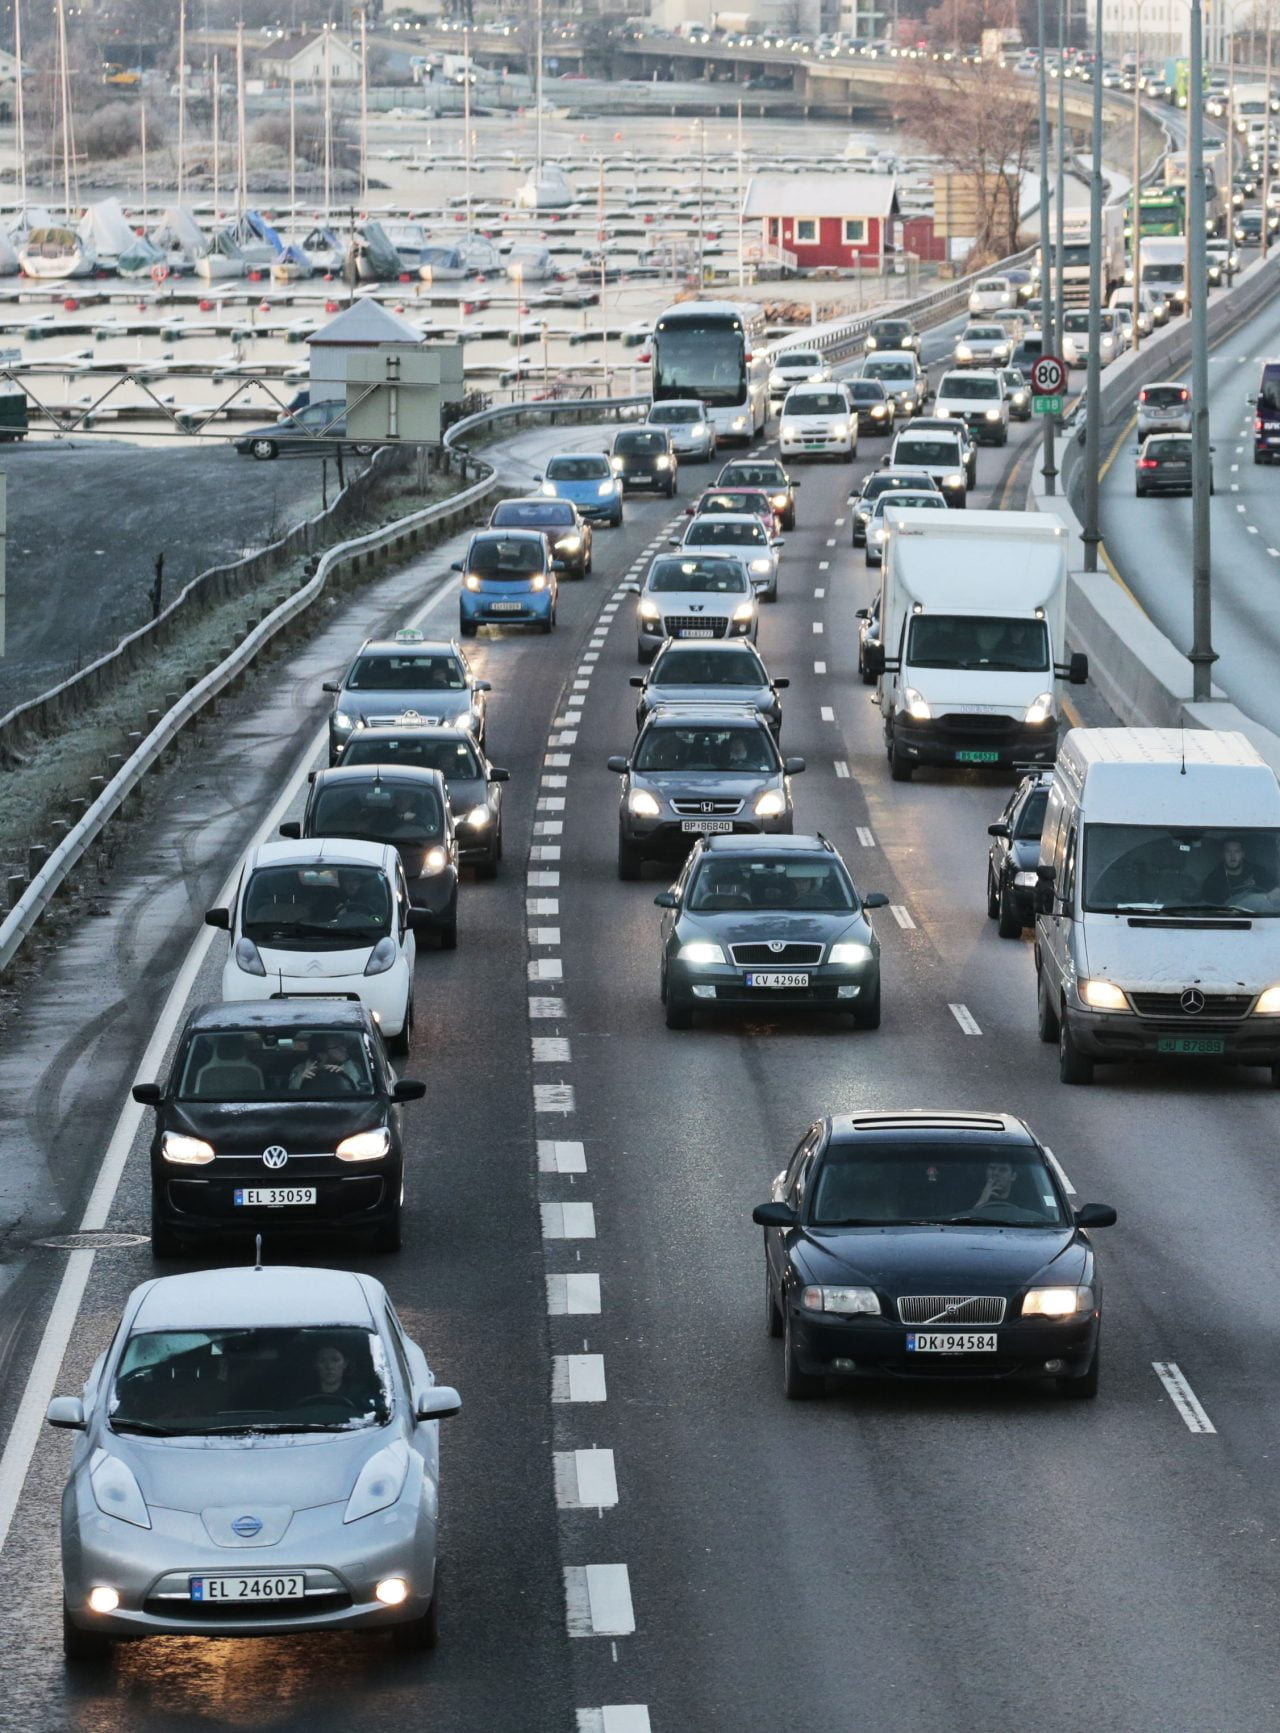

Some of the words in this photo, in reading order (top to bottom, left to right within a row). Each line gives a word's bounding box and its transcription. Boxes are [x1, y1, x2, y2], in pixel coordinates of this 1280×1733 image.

[1038, 366, 1060, 385] 80
[684, 822, 696, 831] BP
[701, 822, 730, 831] 86840
[755, 975, 769, 985] CV
[773, 976, 807, 986] 42966
[248, 1190, 262, 1203] EL
[269, 1189, 312, 1203] 35059
[918, 1335, 938, 1350] DK
[947, 1335, 995, 1350] 94584
[209, 1581, 229, 1597] EL
[239, 1578, 297, 1597] 24602
